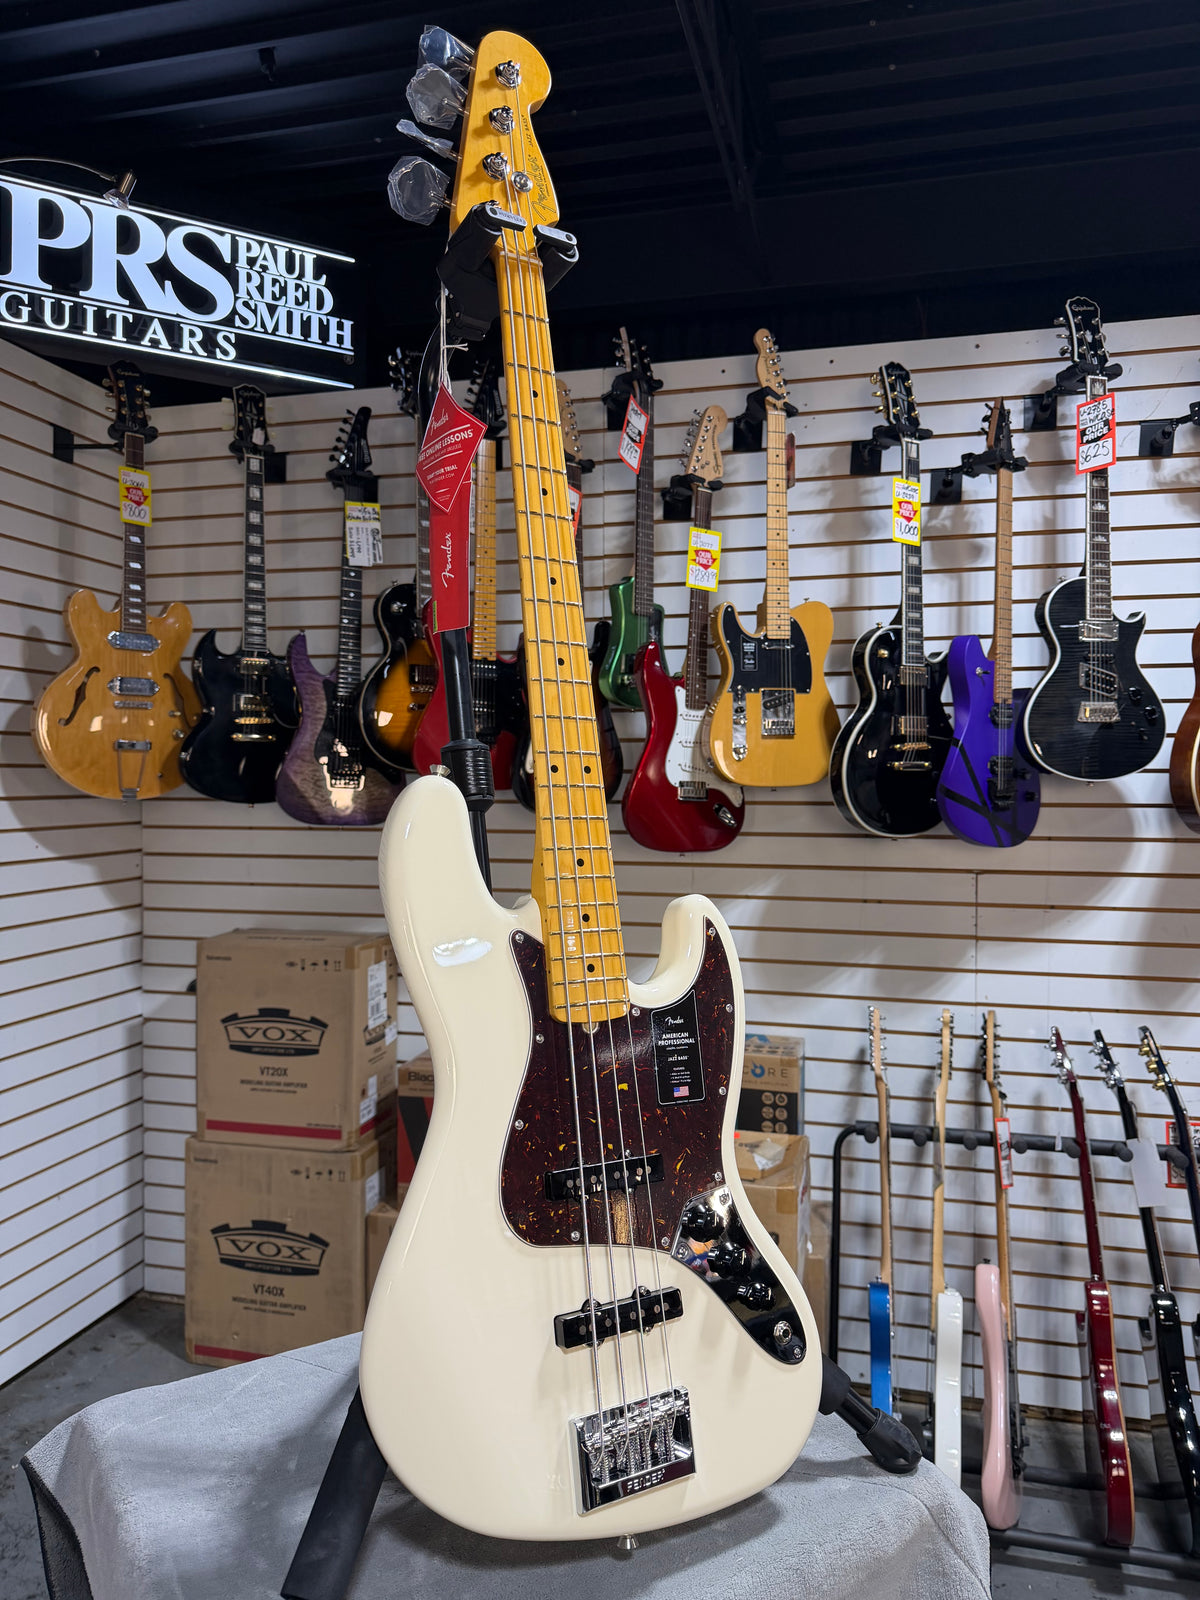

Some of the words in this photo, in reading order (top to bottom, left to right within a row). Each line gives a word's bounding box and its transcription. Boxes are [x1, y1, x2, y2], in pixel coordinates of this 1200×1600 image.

[0, 181, 236, 323] PRS
[235, 236, 327, 286] PAUL
[235, 266, 334, 315] REED
[0, 290, 238, 361] GUITARS
[234, 298, 355, 350] SMITH
[430, 408, 449, 436] Fender
[1085, 421, 1105, 433] OUR
[442, 429, 473, 448] LESSONS
[1083, 428, 1109, 444] PRICE
[1080, 440, 1110, 465] $625
[899, 510, 915, 518] PRICE
[900, 502, 913, 510] OUR
[895, 520, 919, 536] $1,000
[440, 531, 452, 588] Fender
[695, 557, 714, 566] PRICE
[698, 551, 712, 559] OUR
[665, 1016, 684, 1026] Fender
[237, 1026, 313, 1043] VOX
[658, 1038, 696, 1047] PROFESSIONAL
[662, 1031, 689, 1040] AMERICAN
[259, 1066, 289, 1078] VT20X
[226, 1238, 312, 1262] VOX
[252, 1284, 286, 1298] VT40X
